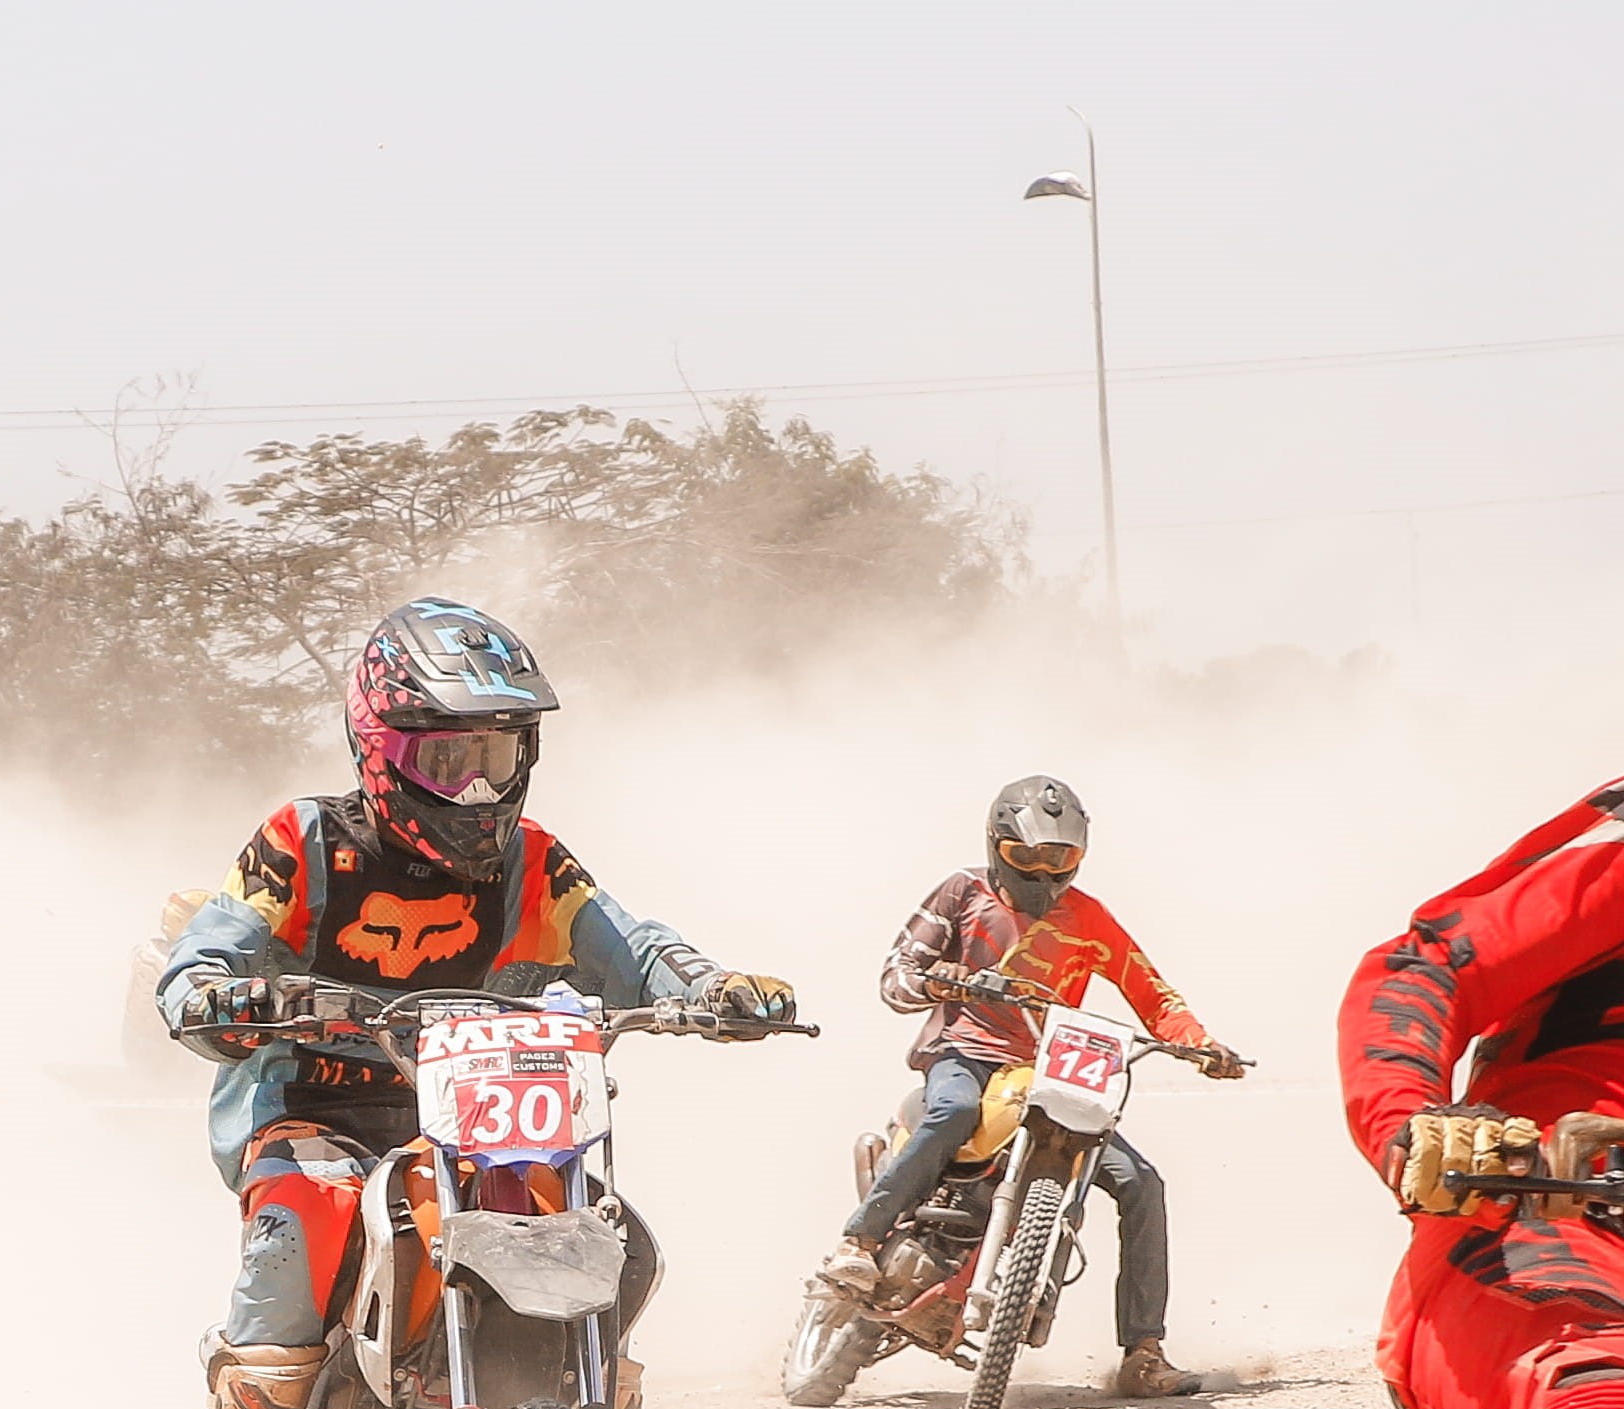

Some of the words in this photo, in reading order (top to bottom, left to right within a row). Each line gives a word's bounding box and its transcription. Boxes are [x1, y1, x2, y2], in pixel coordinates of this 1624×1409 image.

[419, 1015, 596, 1058] MRF
[512, 1062, 565, 1072] CUSTOMS
[1058, 1050, 1109, 1087] 14
[471, 1084, 563, 1145] 30
